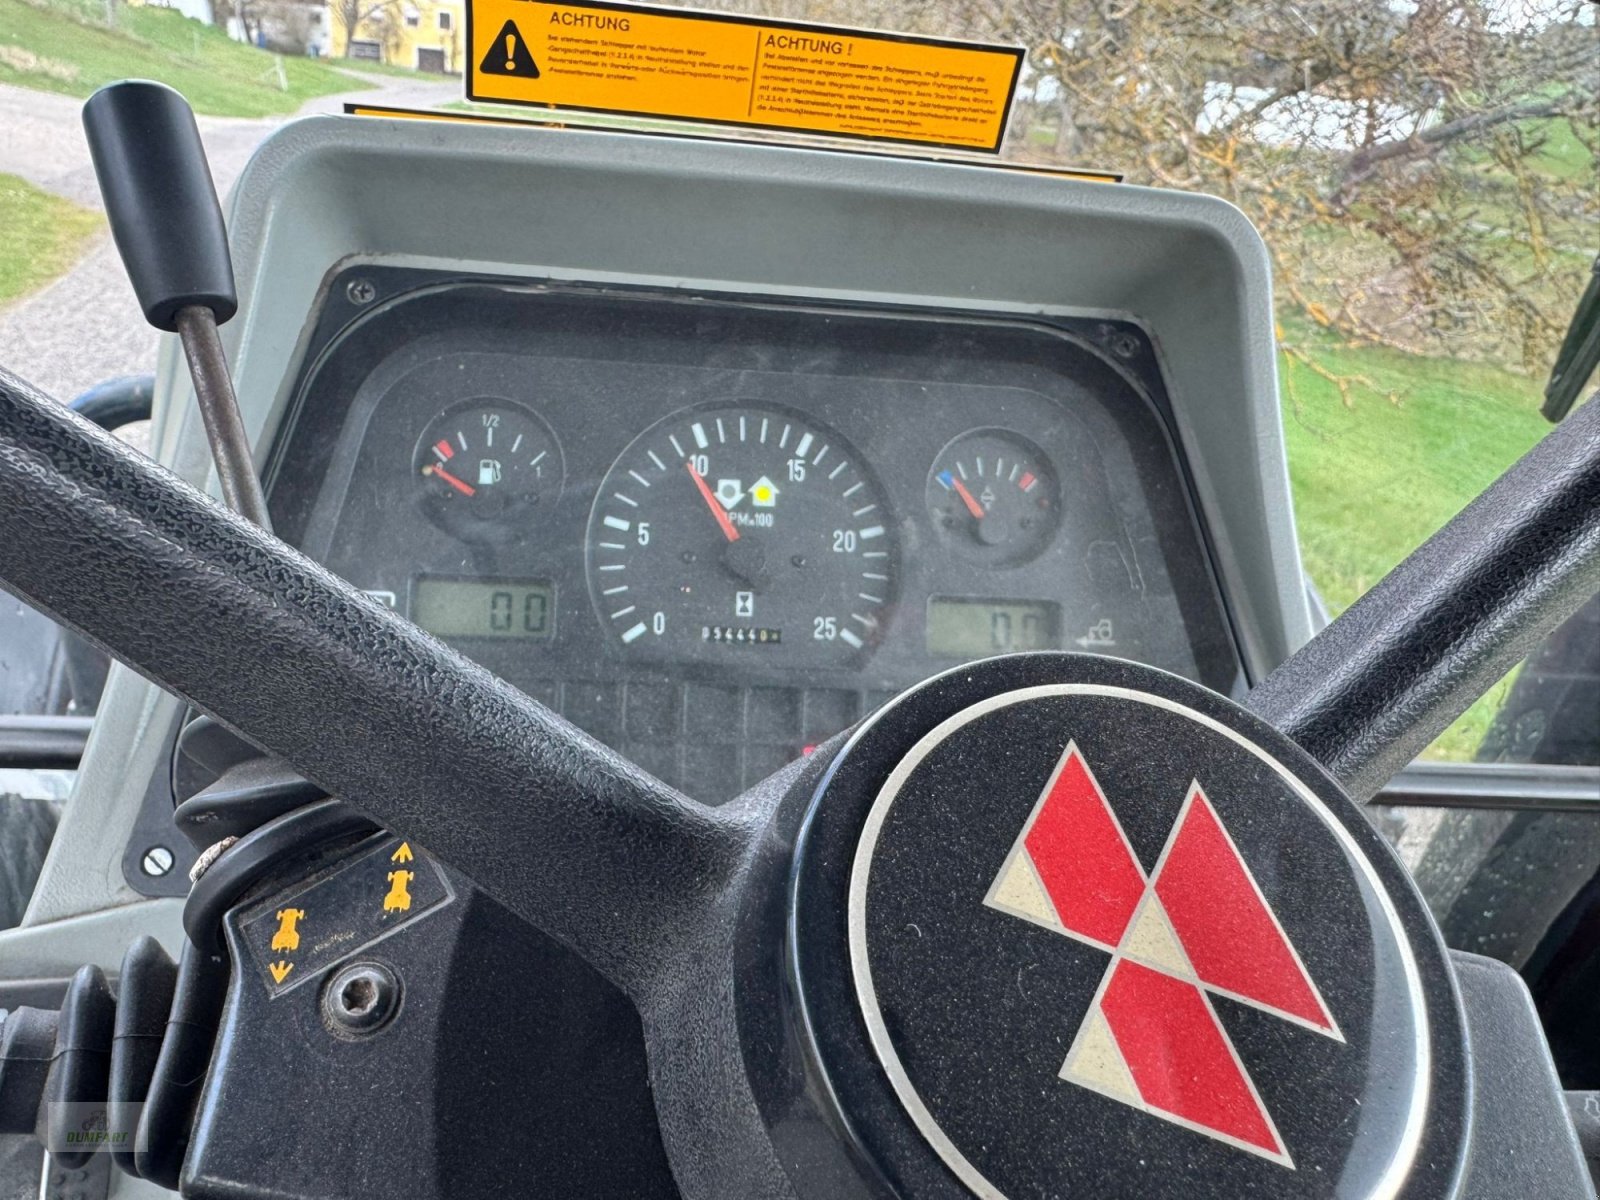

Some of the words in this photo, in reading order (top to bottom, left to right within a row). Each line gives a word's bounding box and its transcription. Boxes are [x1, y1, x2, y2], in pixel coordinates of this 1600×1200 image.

[550, 12, 630, 31] ACHTUNG
[764, 36, 843, 54] ACHTUNG
[689, 454, 709, 477] 10
[786, 459, 806, 482] 15
[637, 524, 650, 546] 5
[832, 530, 856, 553] 20
[652, 613, 666, 634] 0
[813, 617, 837, 641] 25
